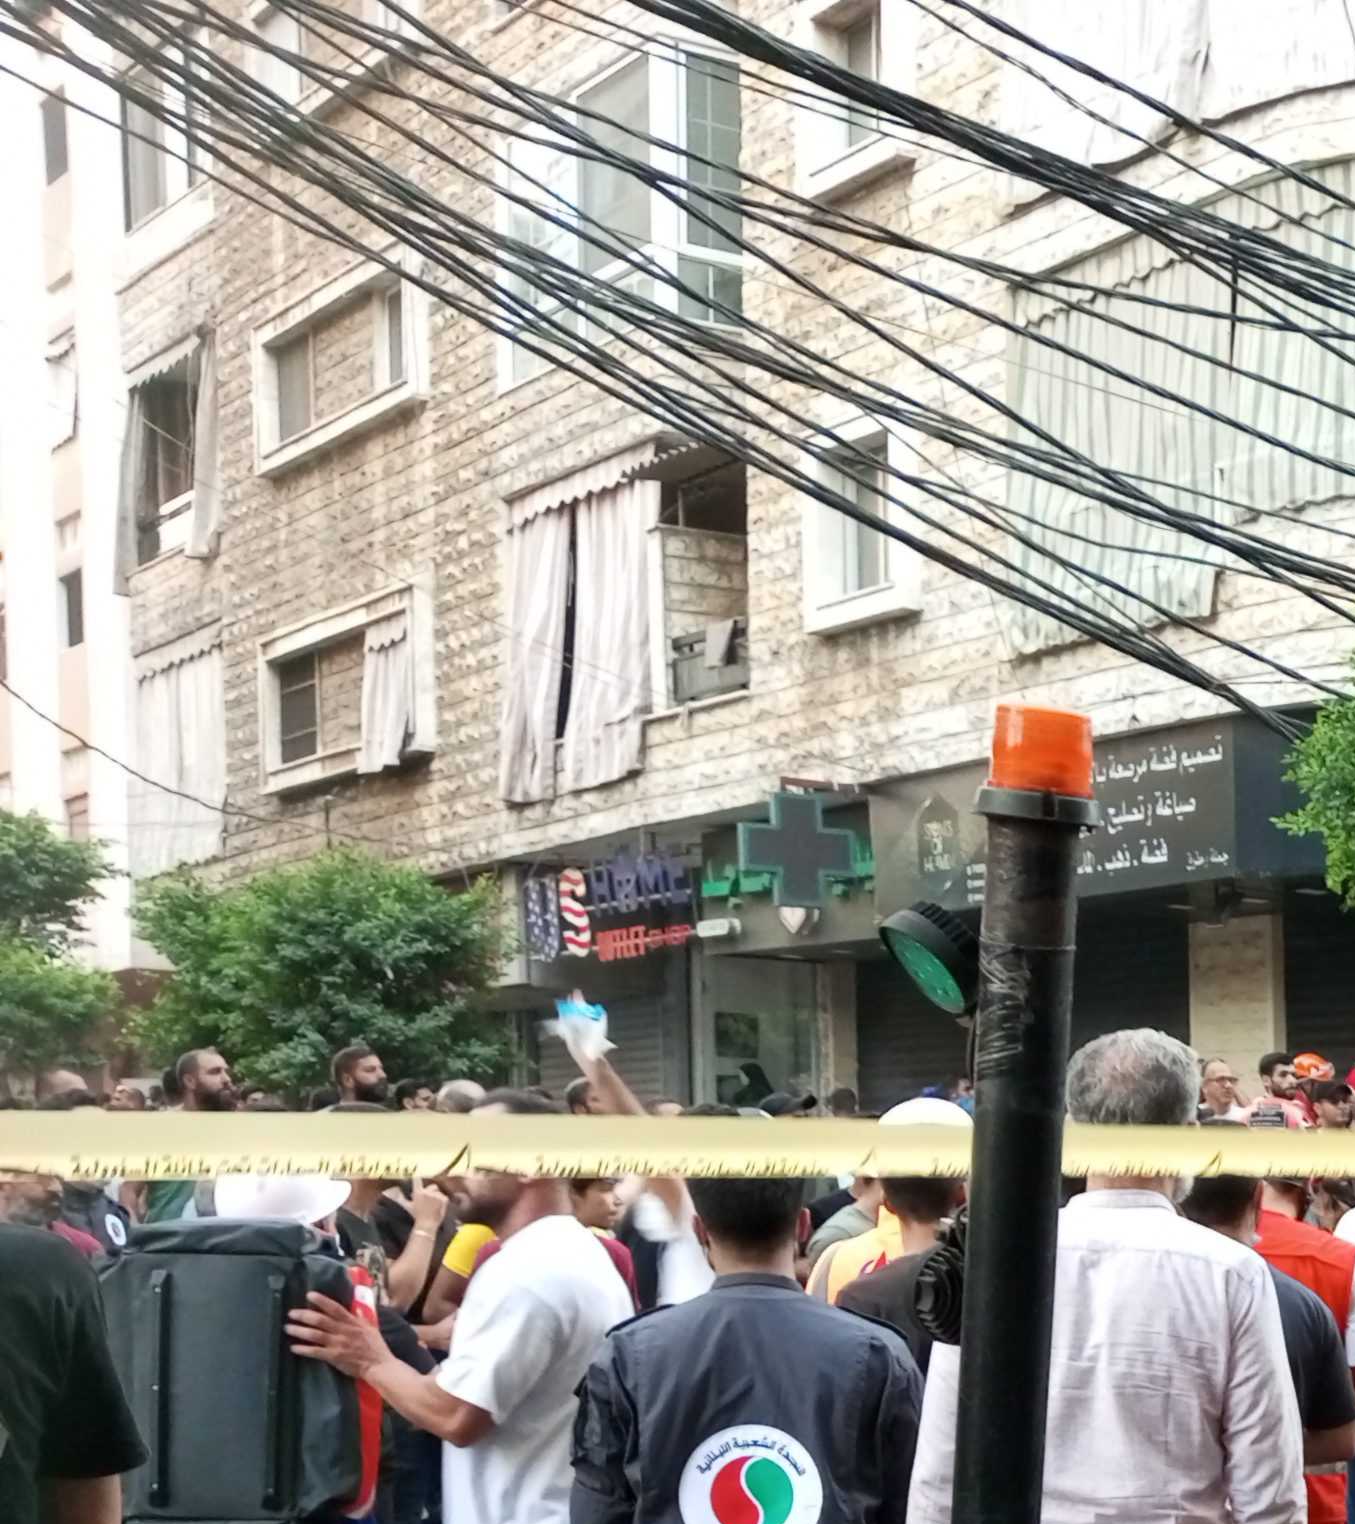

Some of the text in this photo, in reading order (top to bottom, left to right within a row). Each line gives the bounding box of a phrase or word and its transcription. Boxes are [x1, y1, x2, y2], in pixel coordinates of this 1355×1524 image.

[1150, 744, 1177, 771] فضة
[1154, 790, 1197, 821] صياغة
[1138, 838, 1169, 864] فضة
[525, 867, 591, 962] US
